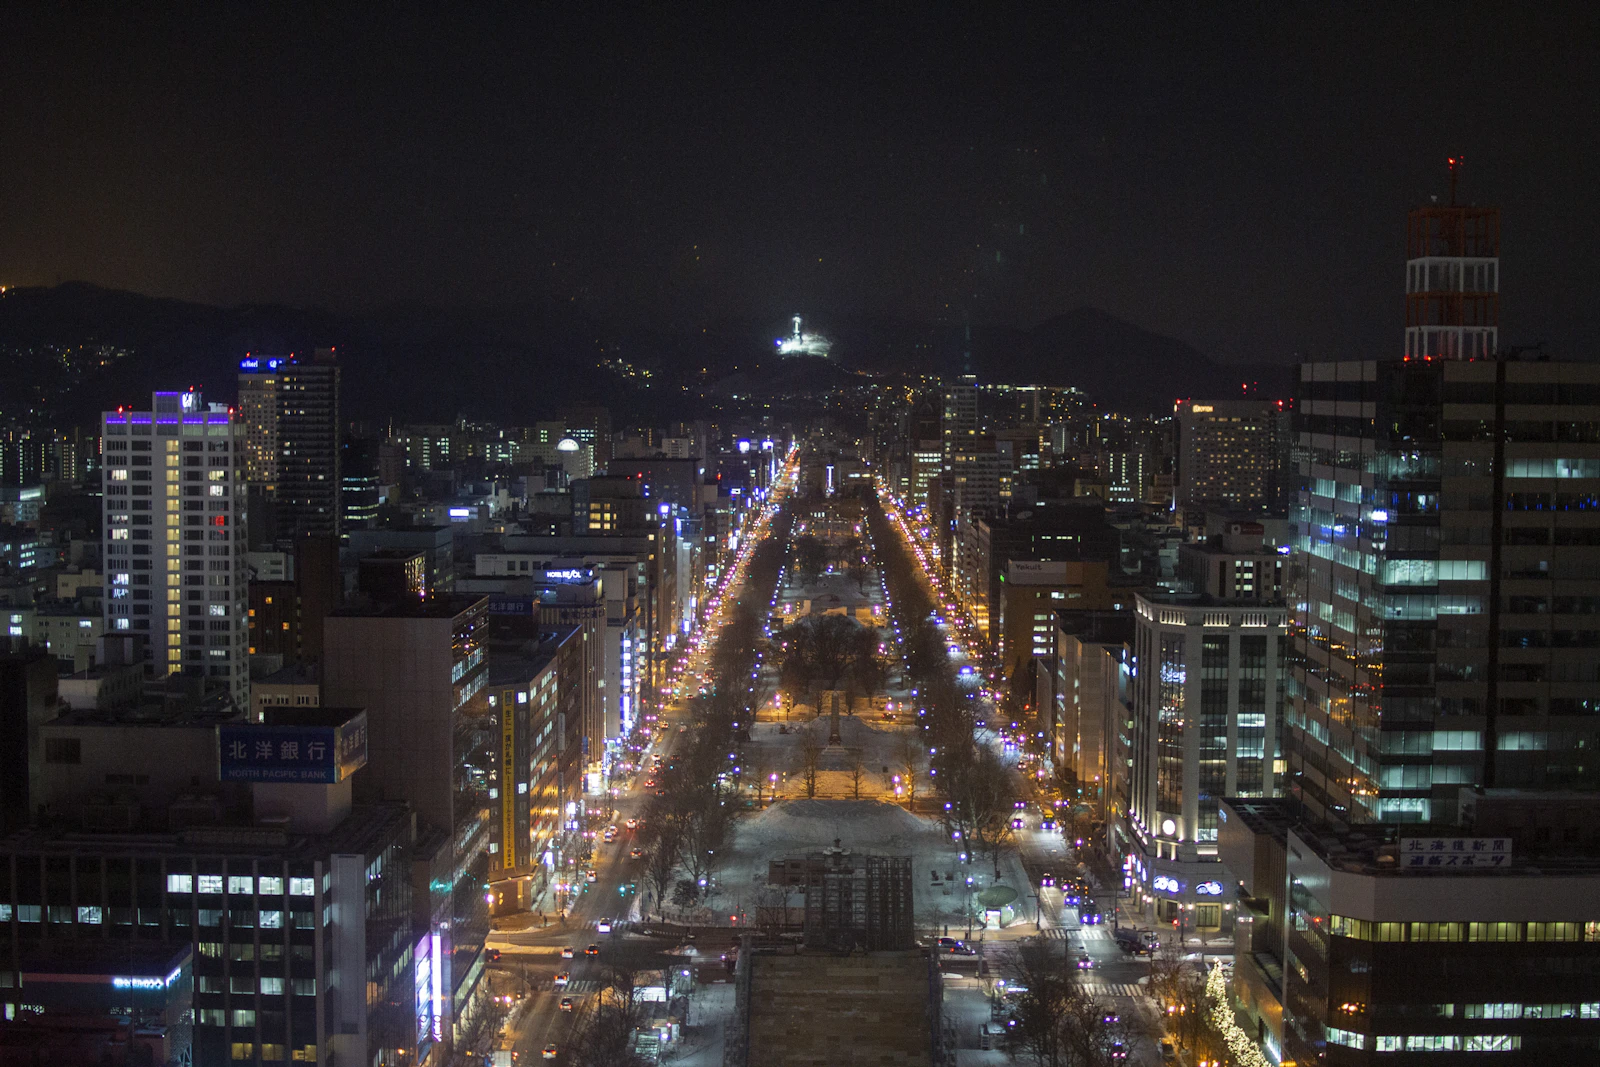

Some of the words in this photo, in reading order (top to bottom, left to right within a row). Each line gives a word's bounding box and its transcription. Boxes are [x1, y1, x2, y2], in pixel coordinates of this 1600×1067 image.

[490, 602, 525, 611] 北洋銀行
[229, 740, 326, 760] 北洋銀行
[229, 769, 260, 778] NORTH
[263, 770, 297, 779] PACIFIC
[301, 770, 327, 779] BANK
[1409, 840, 1505, 851] 北海道新聞
[1410, 854, 1505, 866] 道新スポーツ
